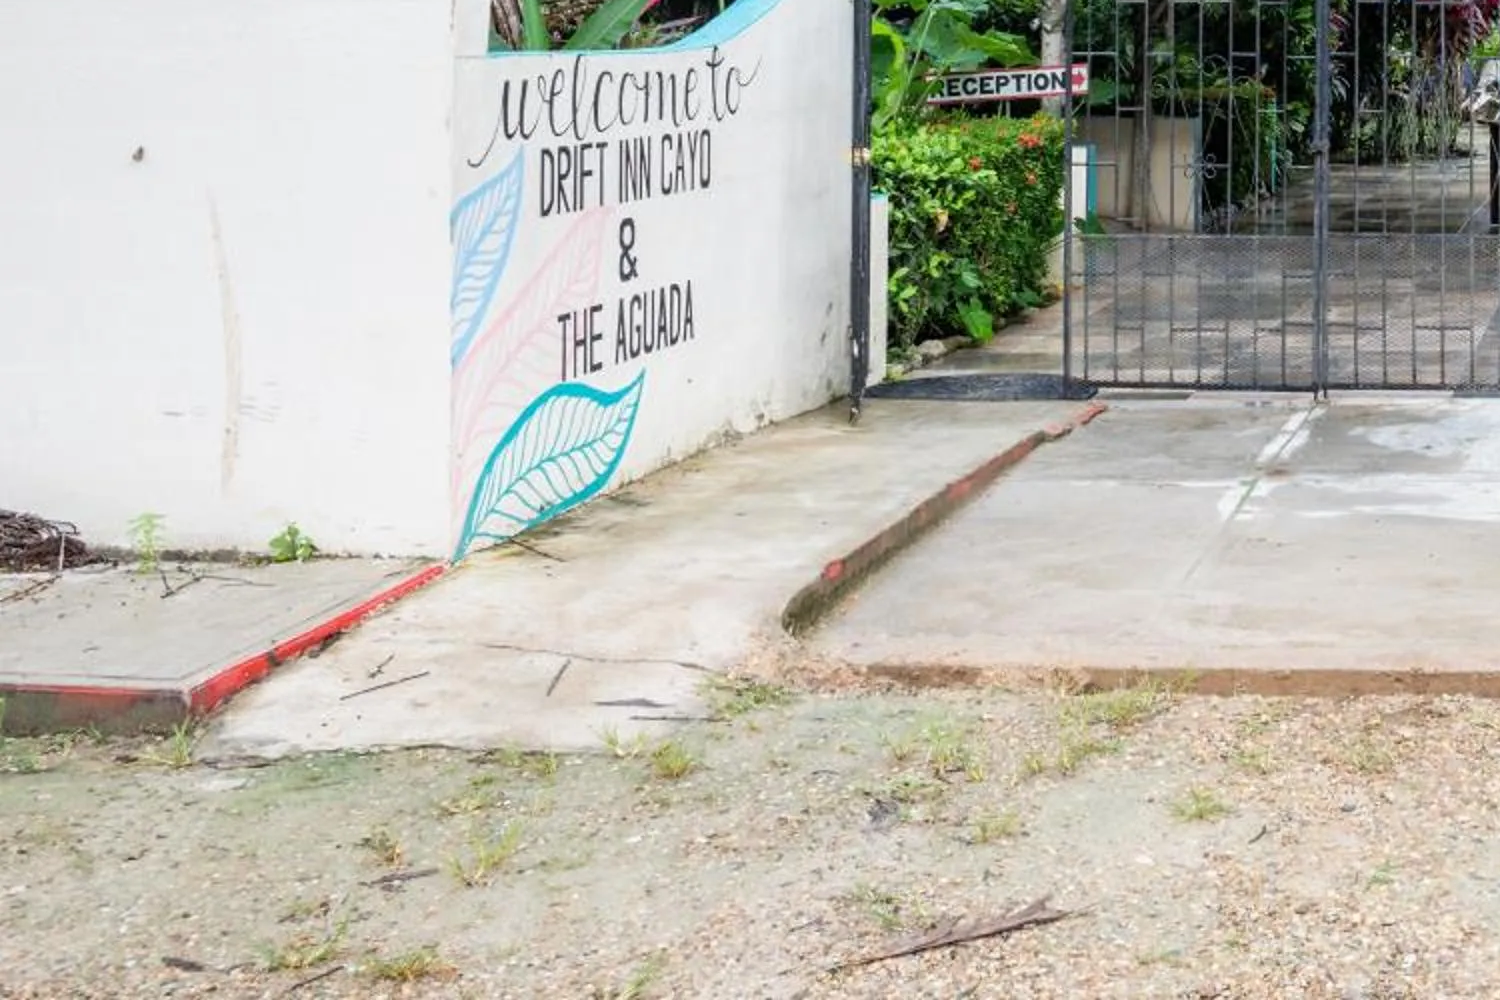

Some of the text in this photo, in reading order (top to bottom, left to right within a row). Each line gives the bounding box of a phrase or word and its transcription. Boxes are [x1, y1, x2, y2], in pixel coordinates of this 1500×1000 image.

[467, 45, 763, 168] welcome to
[539, 129, 712, 217] DRIFT INN CAYO
[618, 217, 639, 282] &
[557, 279, 695, 382] THE AGUADA
